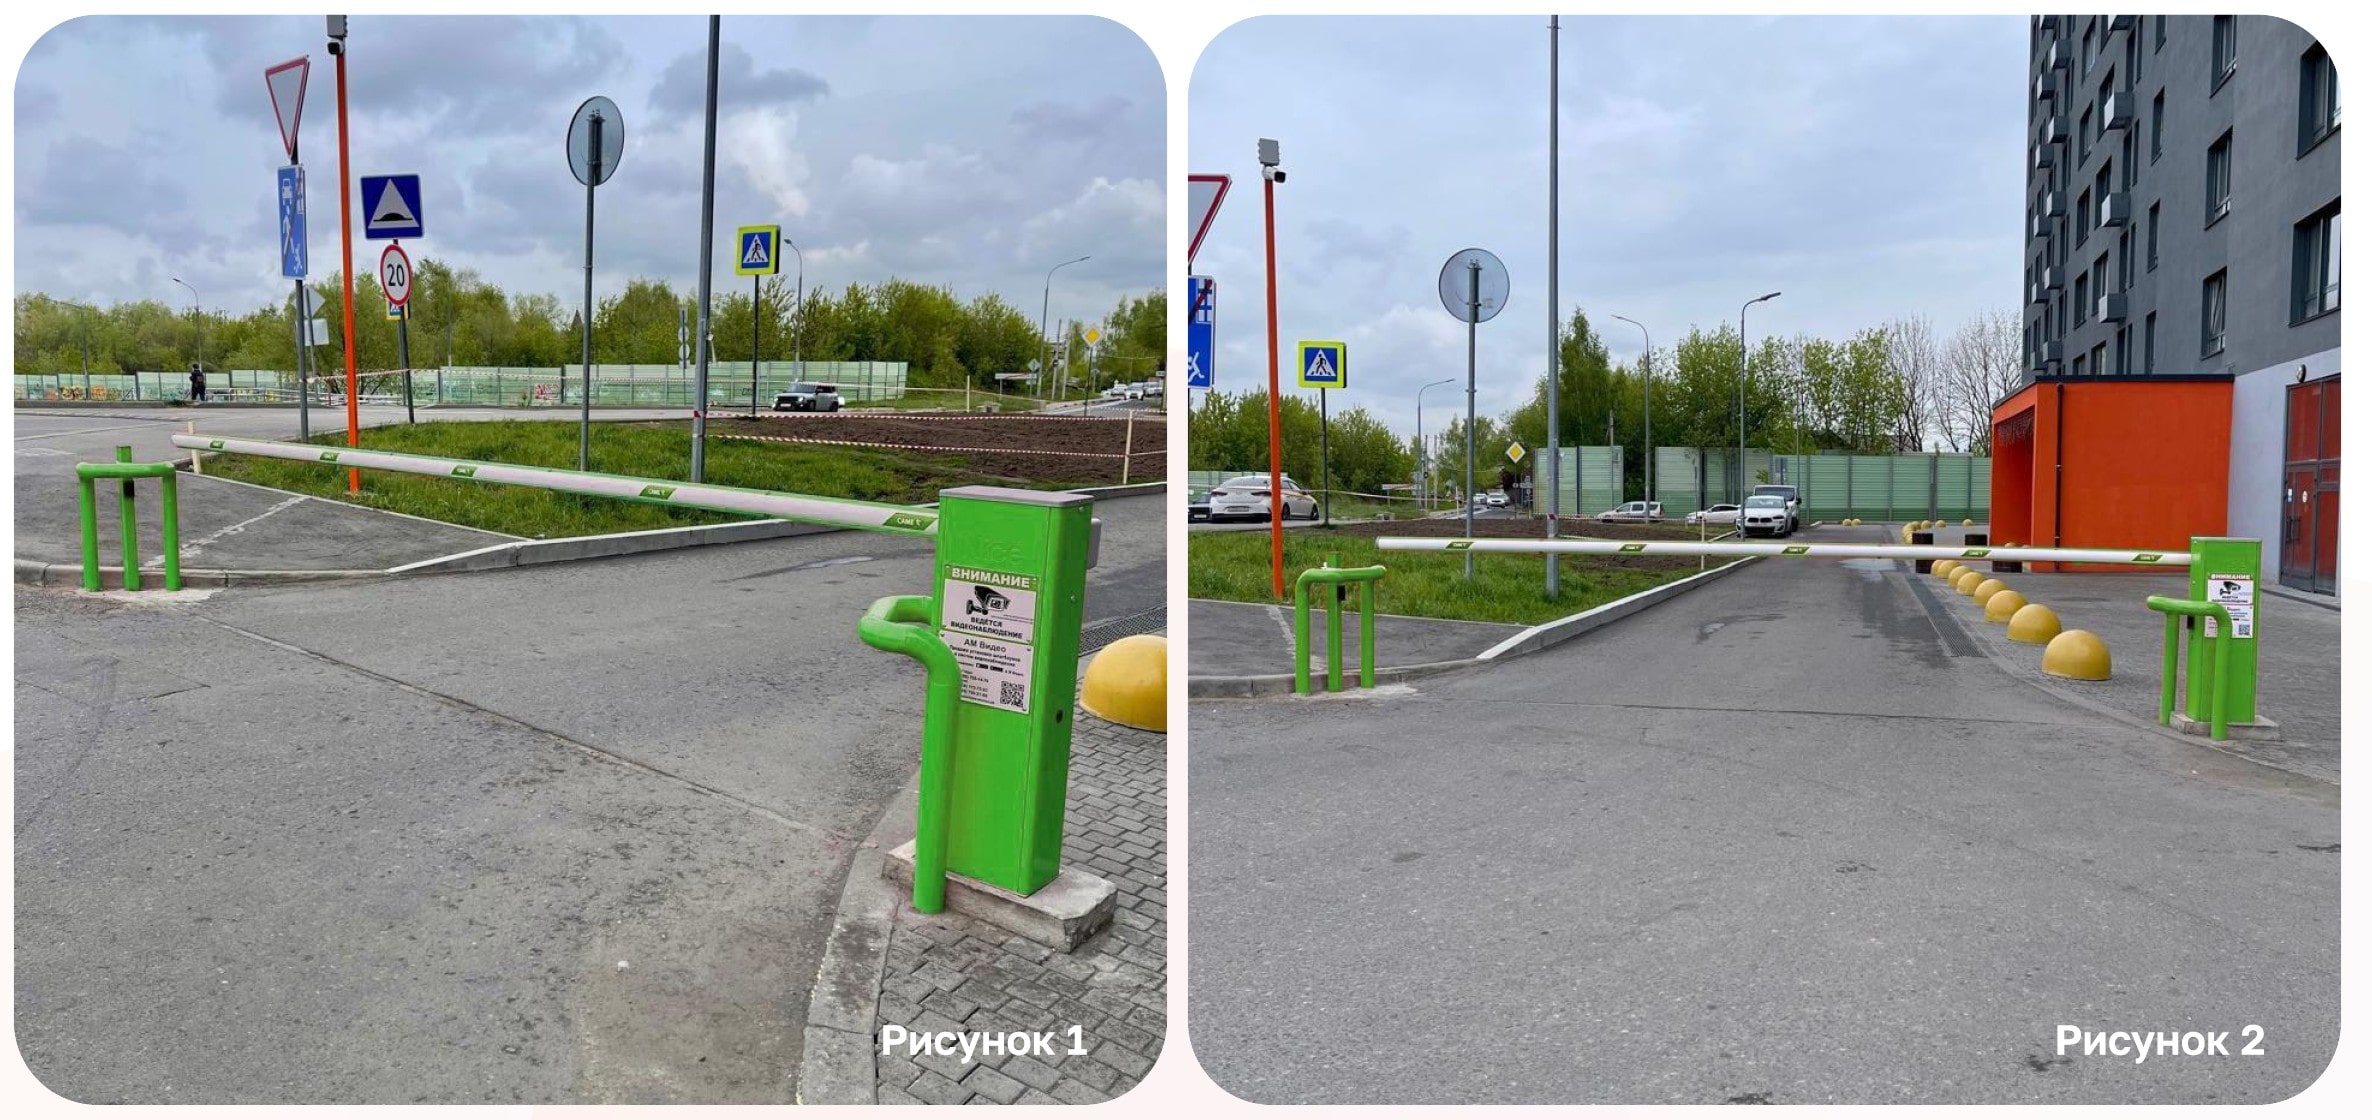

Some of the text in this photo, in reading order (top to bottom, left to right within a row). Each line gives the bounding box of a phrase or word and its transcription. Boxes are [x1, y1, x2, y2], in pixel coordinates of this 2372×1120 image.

[387, 263, 405, 287] 20
[951, 567, 1030, 588] ВНИМАНИЕ
[950, 621, 1023, 639] ВИДЕОНАБЛЮДЕНИЕ
[964, 638, 1007, 653] АМ Видео
